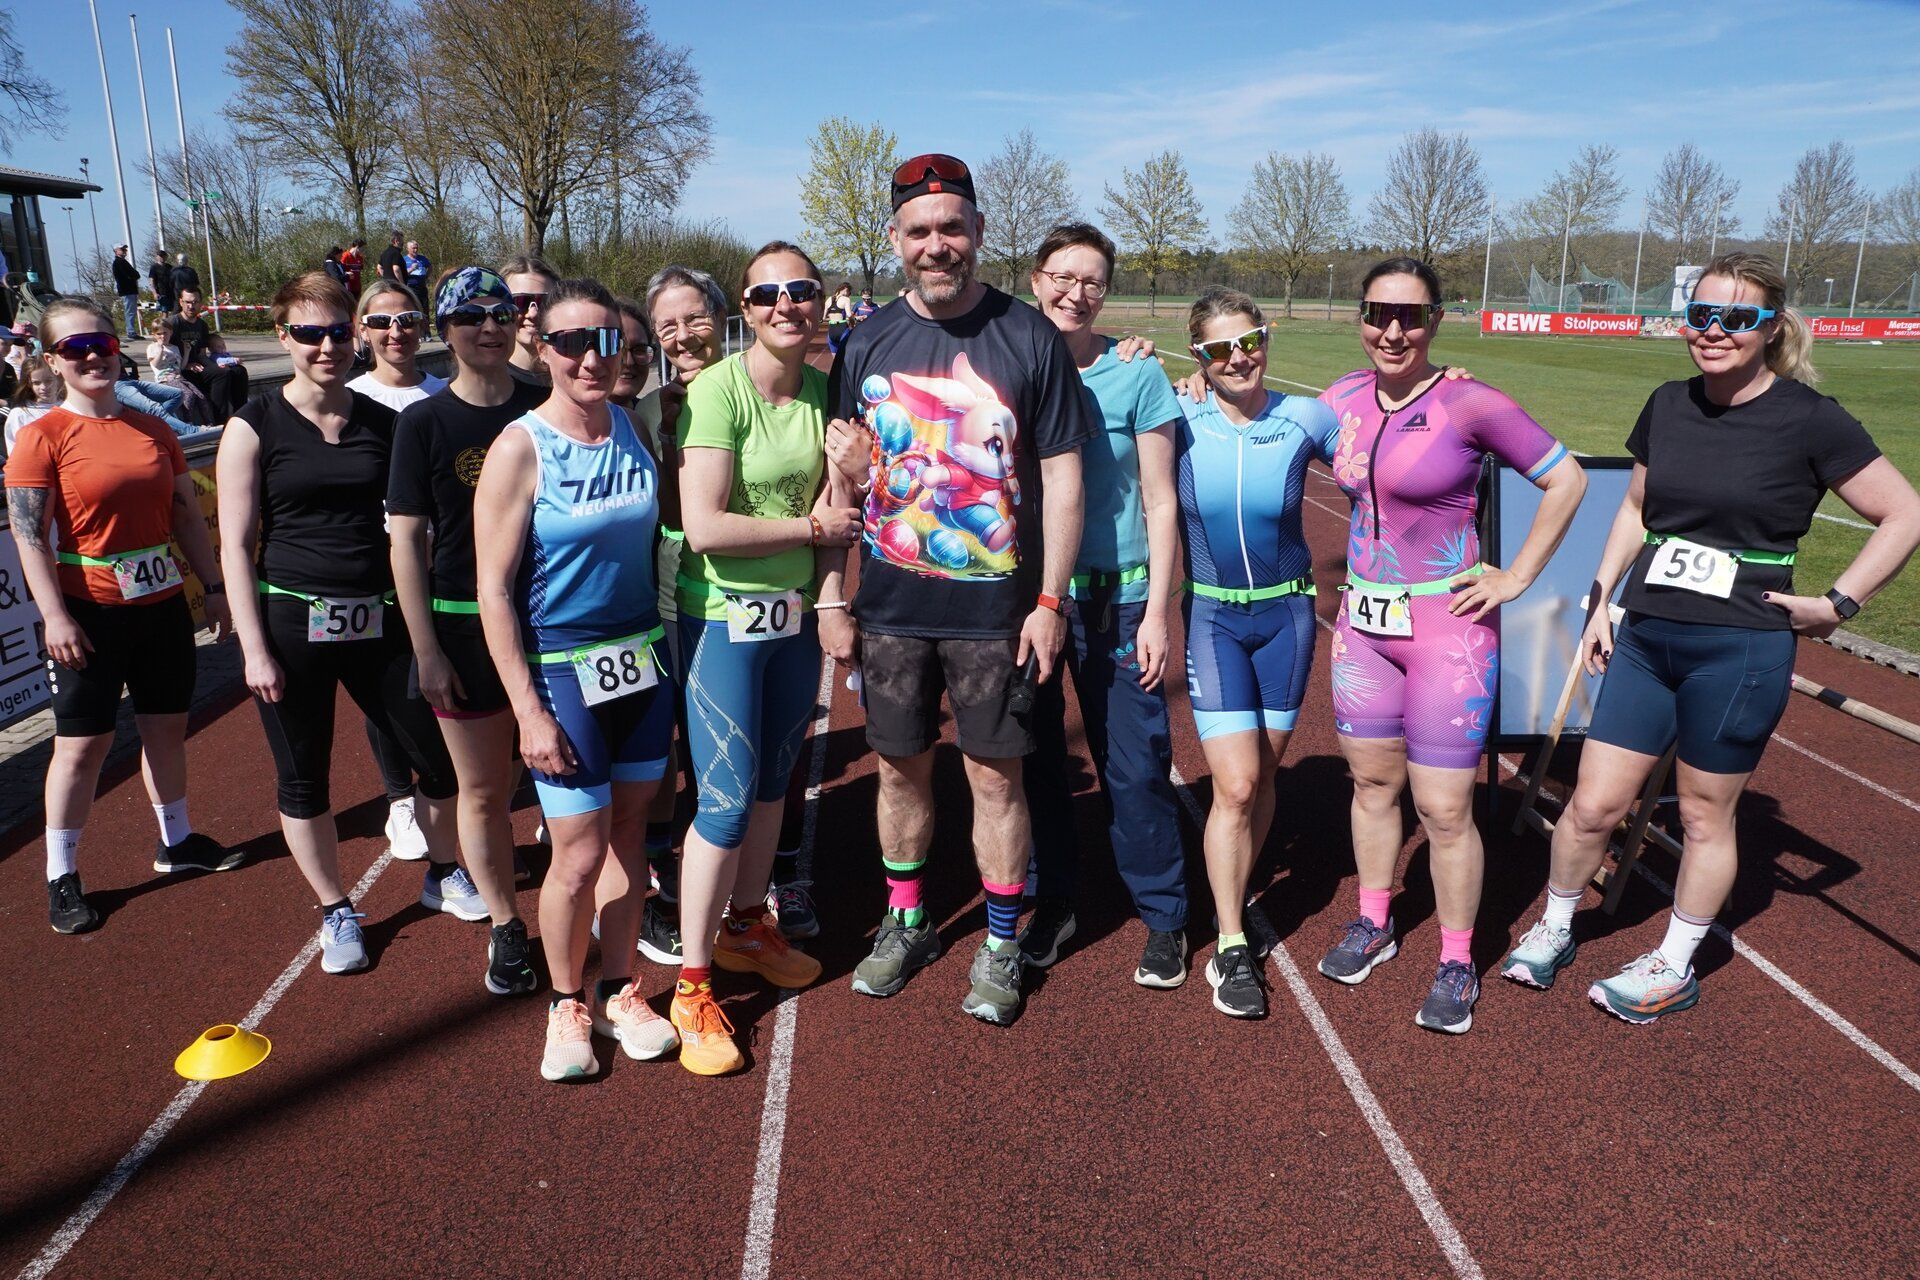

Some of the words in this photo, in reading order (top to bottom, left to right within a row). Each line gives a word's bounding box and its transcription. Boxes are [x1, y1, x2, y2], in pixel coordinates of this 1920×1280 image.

[1491, 312, 1552, 332] REWE
[1563, 316, 1639, 332] Stolpowski
[1811, 318, 1838, 332] Flora
[1839, 320, 1864, 333] Insel
[571, 491, 648, 519] NEUMARKT
[134, 556, 168, 587] 40
[1663, 547, 1716, 583] 59
[326, 603, 370, 635] 50
[745, 599, 789, 634] 20
[1358, 595, 1391, 628] 47
[595, 649, 641, 692] 88
